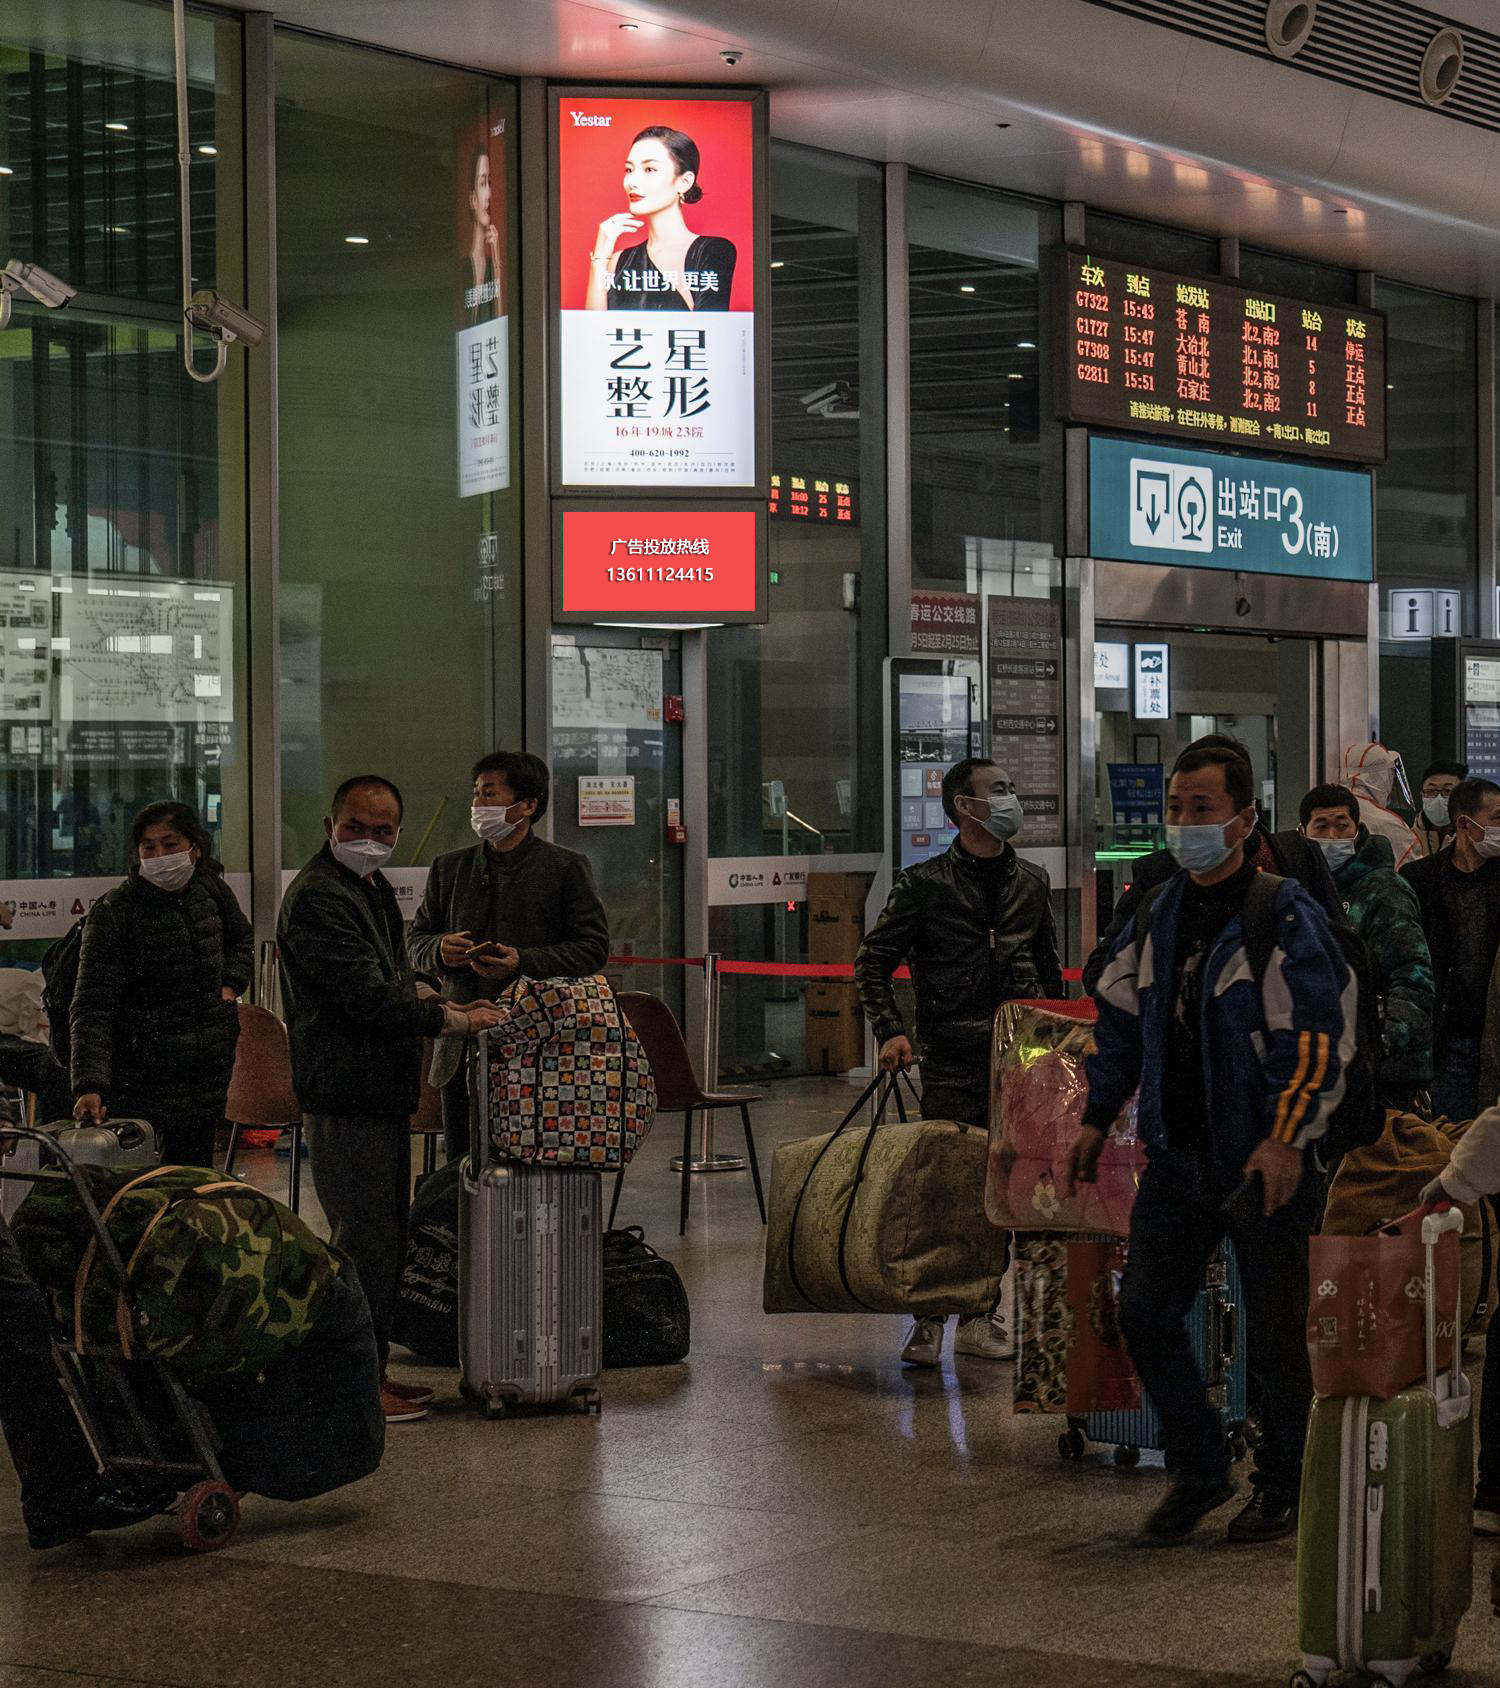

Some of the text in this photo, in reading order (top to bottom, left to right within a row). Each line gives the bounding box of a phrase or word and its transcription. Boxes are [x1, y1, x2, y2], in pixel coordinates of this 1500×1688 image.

[570, 111, 612, 127] Yestar
[1080, 263, 1366, 339] 车次 到点 始发站 出站口 站台 状态
[1076, 291, 1109, 312] G7322
[1123, 300, 1155, 321] 15:43
[1306, 335, 1317, 351] 14
[1345, 341, 1365, 363] 停运
[605, 328, 710, 371] 艺星
[1076, 317, 1109, 338] G1727
[1124, 326, 1155, 346] 15:47
[1308, 360, 1316, 375] 5
[1345, 364, 1366, 386] 正点
[1077, 339, 1109, 360] G7308
[1124, 349, 1155, 368] 15:47
[1176, 354, 1210, 379] 黄山北
[1308, 381, 1316, 395] 8
[1345, 385, 1366, 406] 正点
[605, 376, 712, 419] 整形
[1077, 363, 1109, 384] G2811
[1124, 372, 1155, 391] 15:51
[1176, 377, 1210, 402] 石家庄
[1306, 402, 1317, 417] 11
[1345, 406, 1366, 427] 正点
[629, 449, 690, 458] 400-620-1992
[610, 538, 710, 557] 广告投放热线
[1218, 526, 1243, 550] Exit
[606, 566, 715, 583] 13611124415
[1150, 676, 1161, 713] 补票处
[19, 901, 57, 910] 中国人寿
